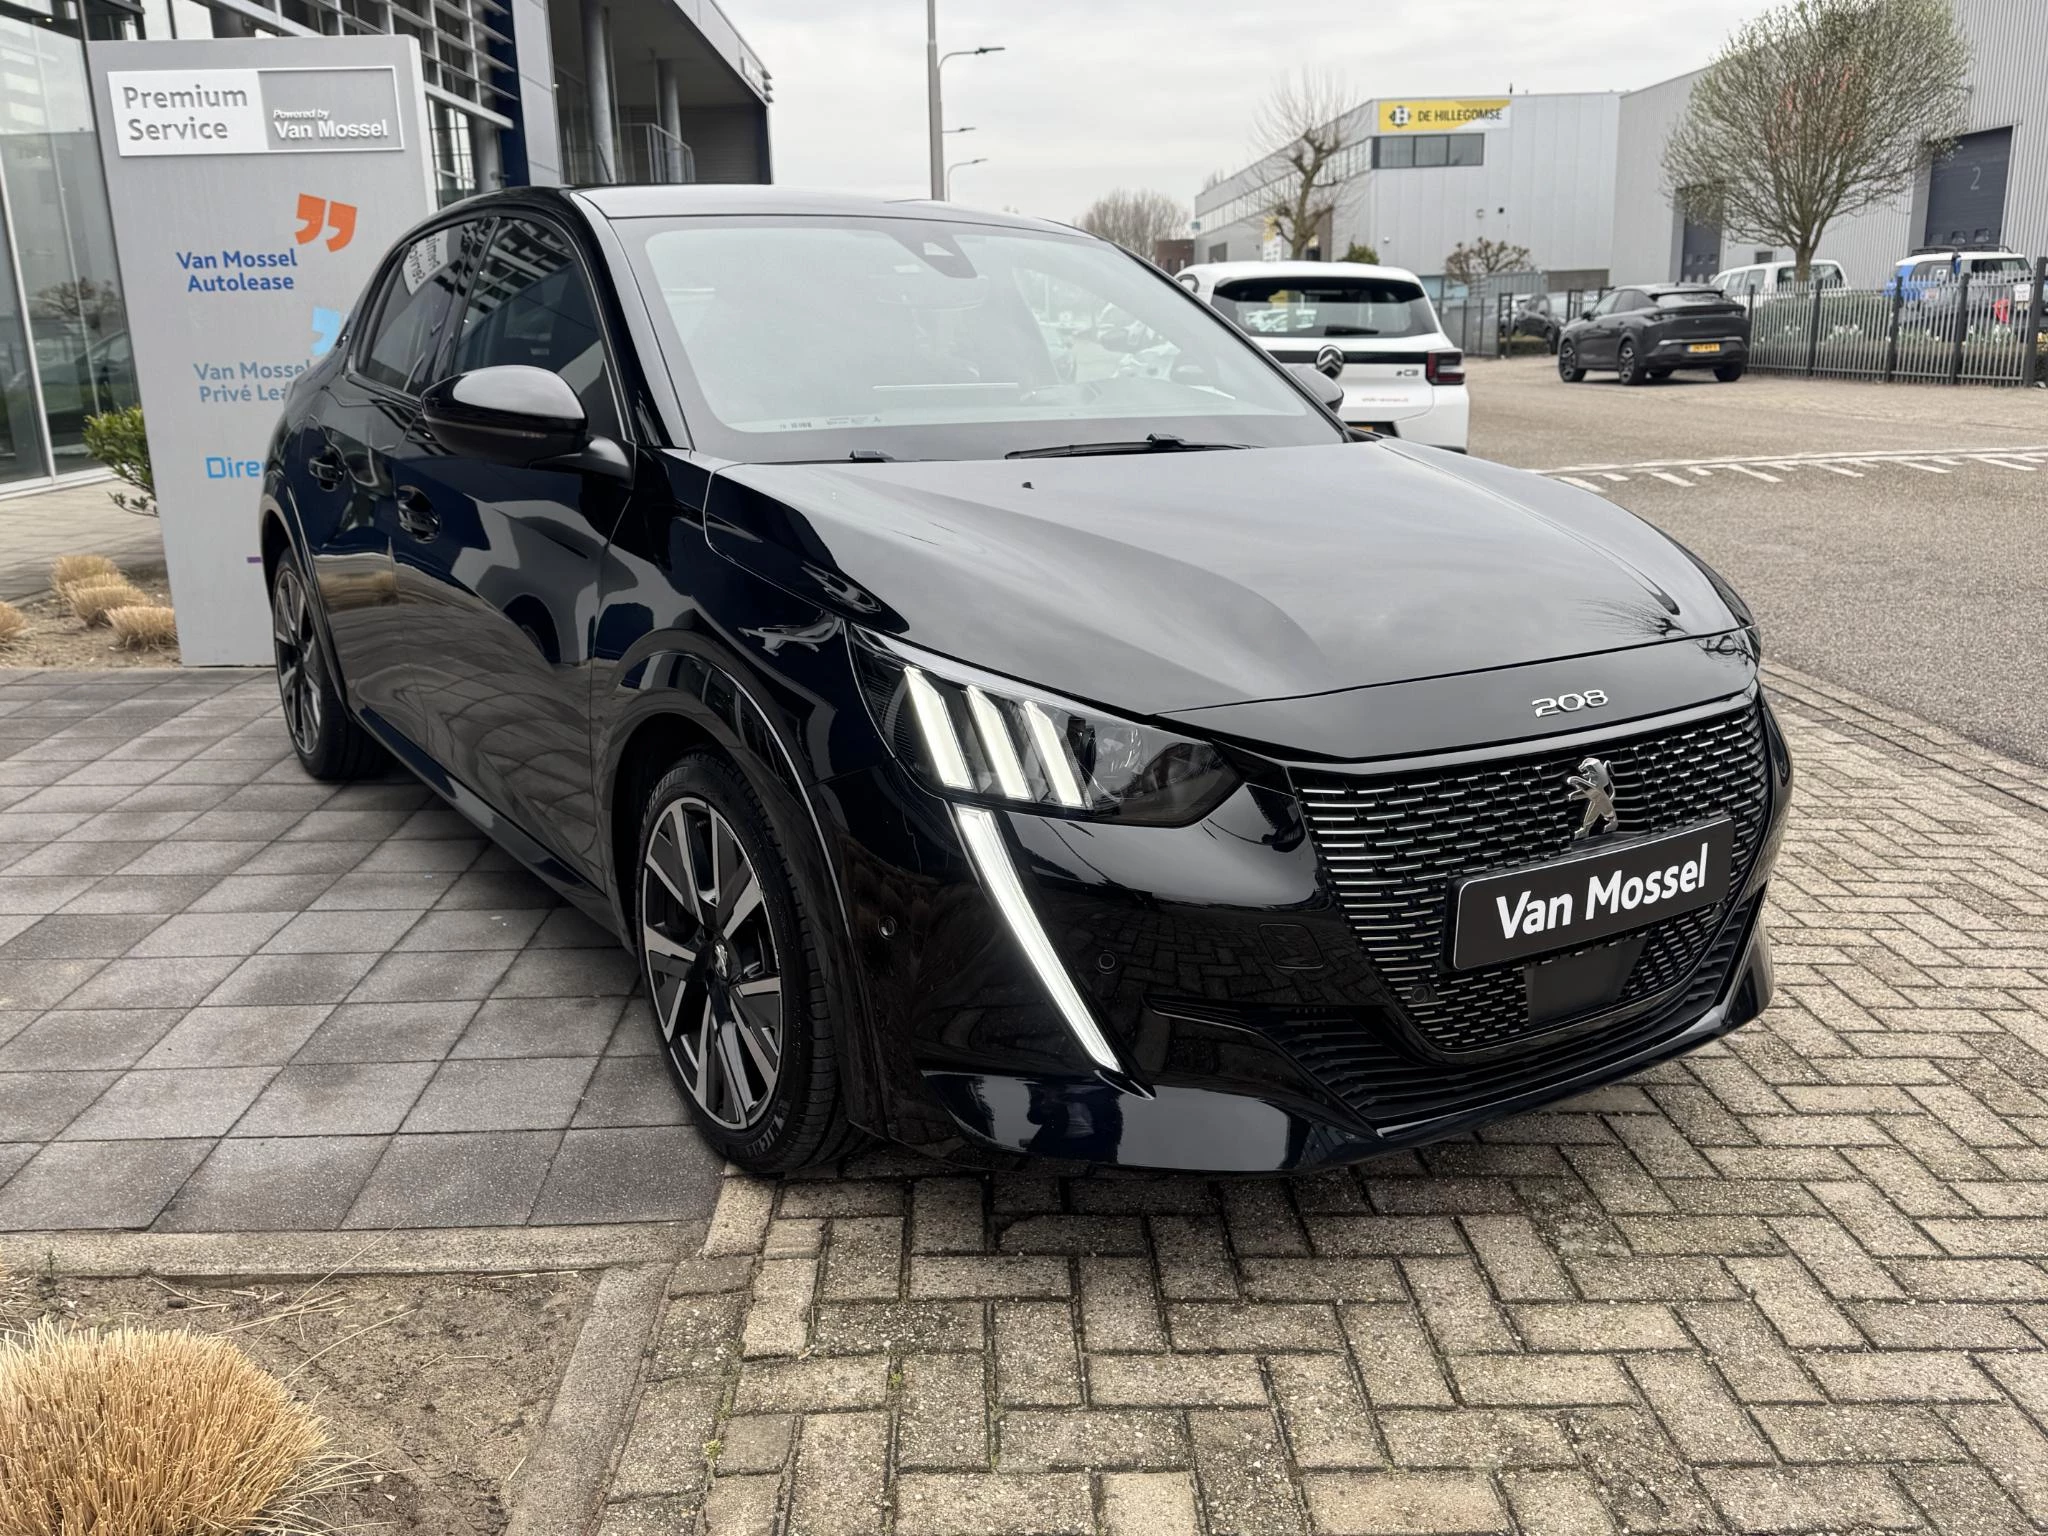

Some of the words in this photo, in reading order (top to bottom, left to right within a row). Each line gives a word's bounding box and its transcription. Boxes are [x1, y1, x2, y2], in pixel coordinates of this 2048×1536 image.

[122, 84, 248, 109] Premium
[273, 109, 315, 119] Powered
[317, 109, 330, 120] by
[1418, 110, 1430, 122] DE
[1434, 108, 1502, 121] HILLEGOMSE
[128, 116, 228, 140] Service
[274, 121, 313, 138] Van
[318, 119, 388, 138] Mossel
[1970, 166, 1981, 190] 2
[176, 251, 218, 270] Van
[222, 248, 298, 268] Mossel
[188, 272, 295, 292] Autolease
[193, 363, 235, 380] Van
[199, 384, 252, 402] Privé
[1531, 689, 1609, 717] 208
[1495, 890, 1573, 939] Van
[1585, 842, 1708, 921] Mossel
